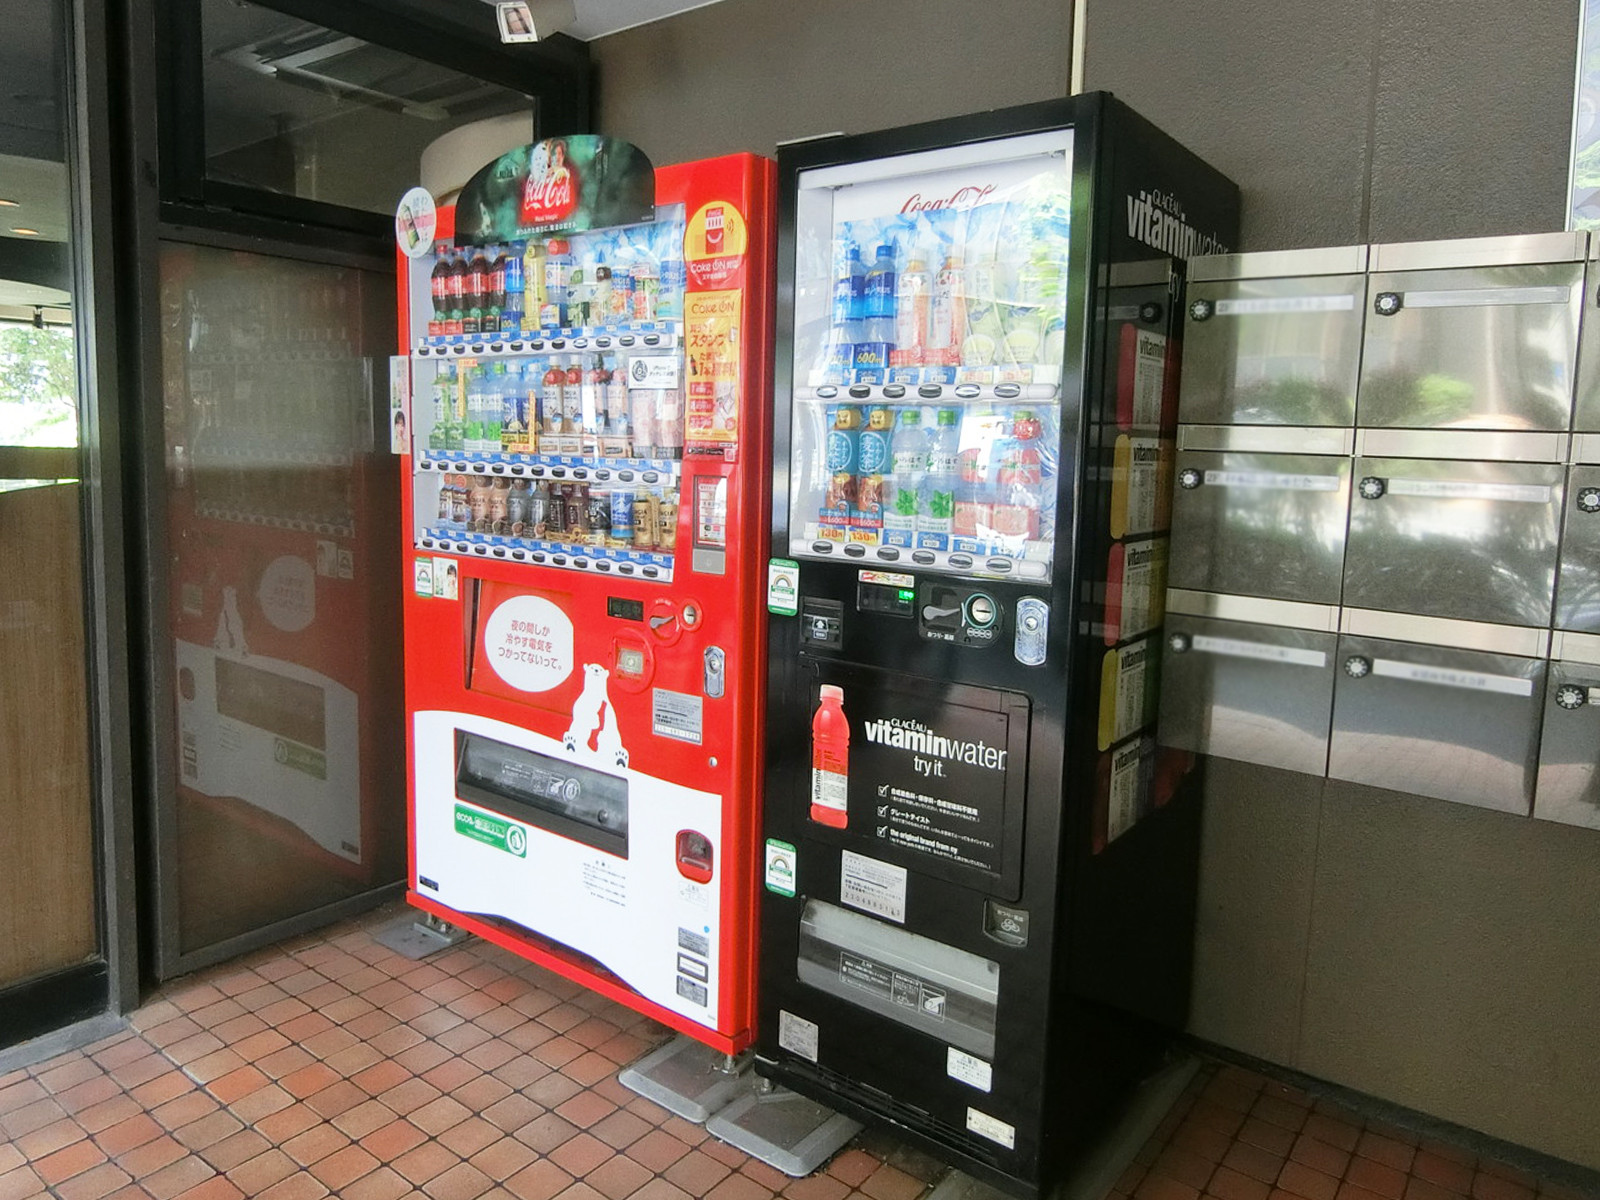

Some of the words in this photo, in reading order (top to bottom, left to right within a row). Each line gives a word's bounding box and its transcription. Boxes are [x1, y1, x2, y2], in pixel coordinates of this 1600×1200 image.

[690, 262, 711, 275] Coke
[712, 259, 727, 271] ON
[691, 303, 717, 314] Coke
[718, 301, 735, 313] ON
[511, 619, 551, 637] 夜の間しか
[506, 633, 553, 653] 冷やす電気を
[498, 646, 562, 671] つかってないって。
[891, 717, 927, 733] GLACÉAU
[913, 755, 932, 777] try
